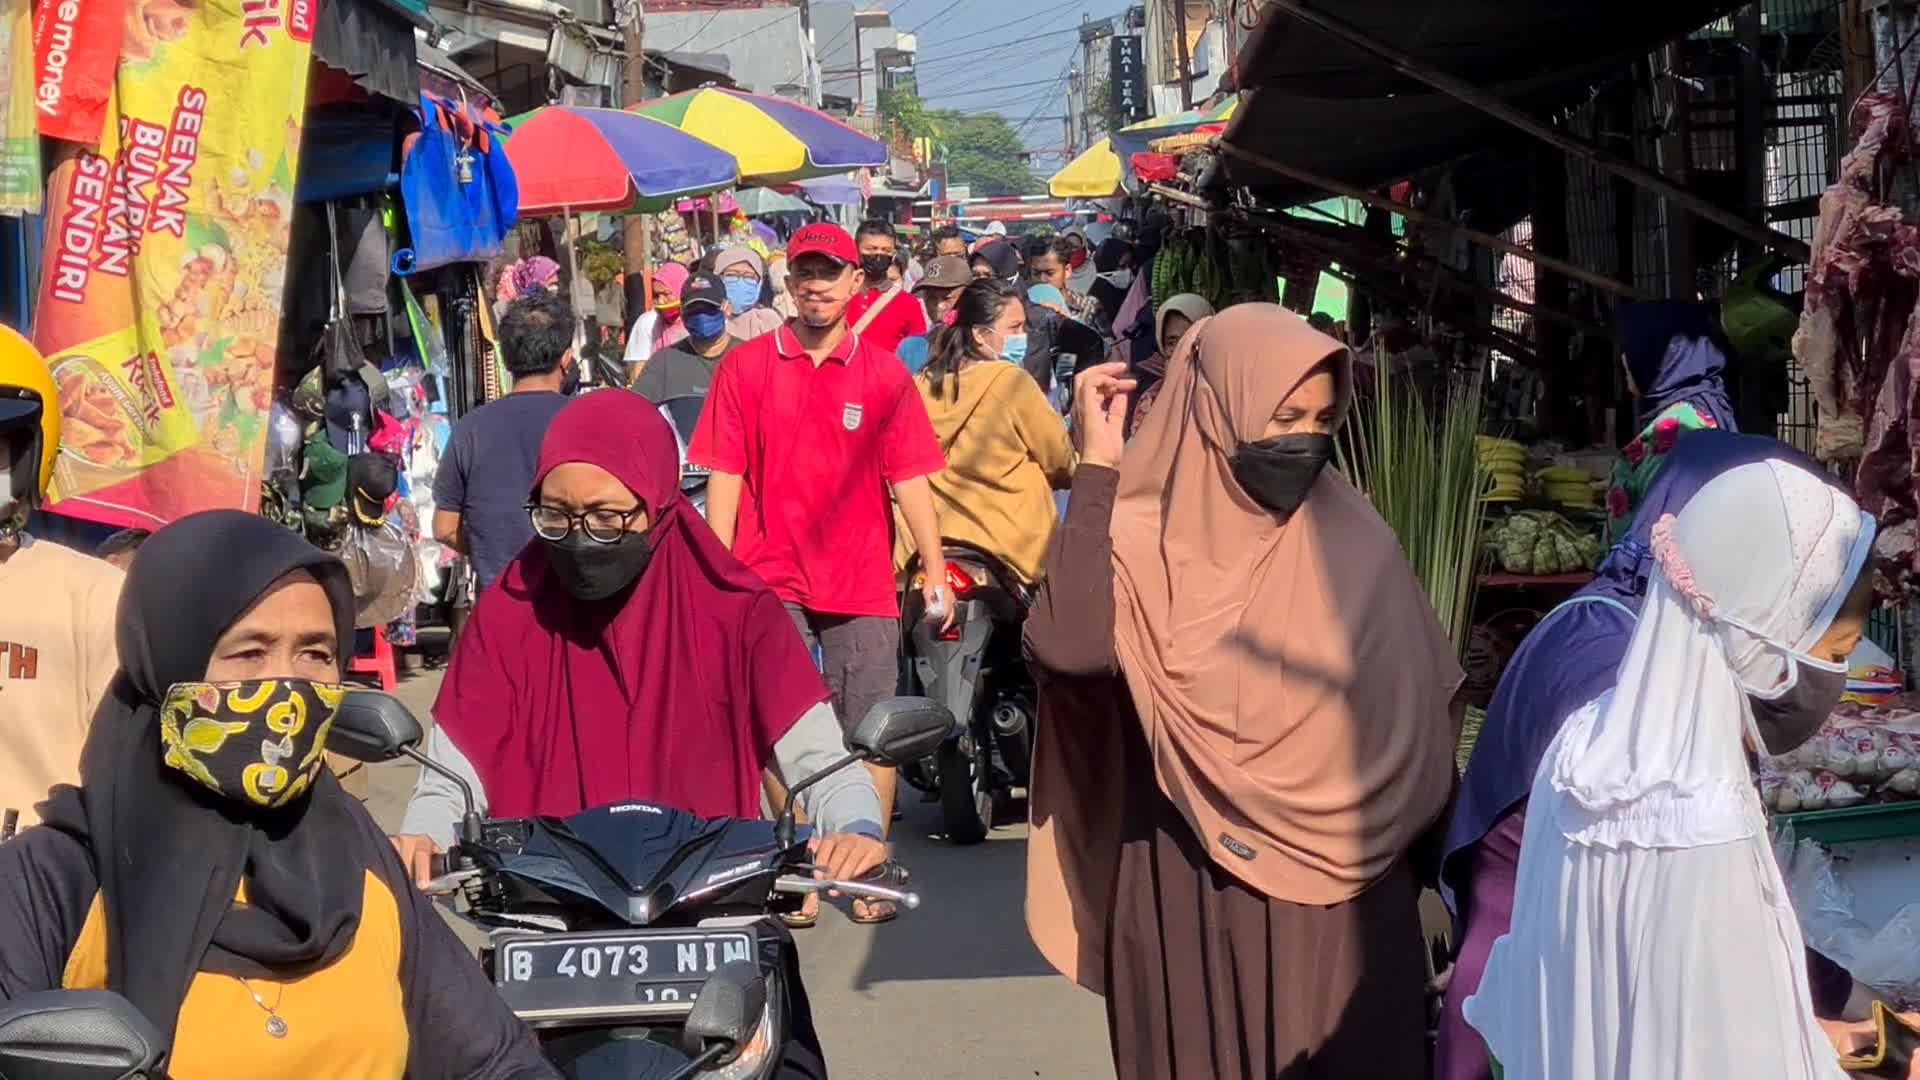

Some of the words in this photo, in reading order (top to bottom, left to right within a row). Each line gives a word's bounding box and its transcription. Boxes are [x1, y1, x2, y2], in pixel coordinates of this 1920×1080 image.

[1120, 38, 1132, 73] THAI
[1122, 79, 1133, 105] TEA
[152, 87, 205, 237] SEENAK
[54, 154, 107, 301] SENDIRI
[609, 804, 663, 815] HONDA
[512, 951, 532, 980] B
[556, 945, 649, 977] 4073
